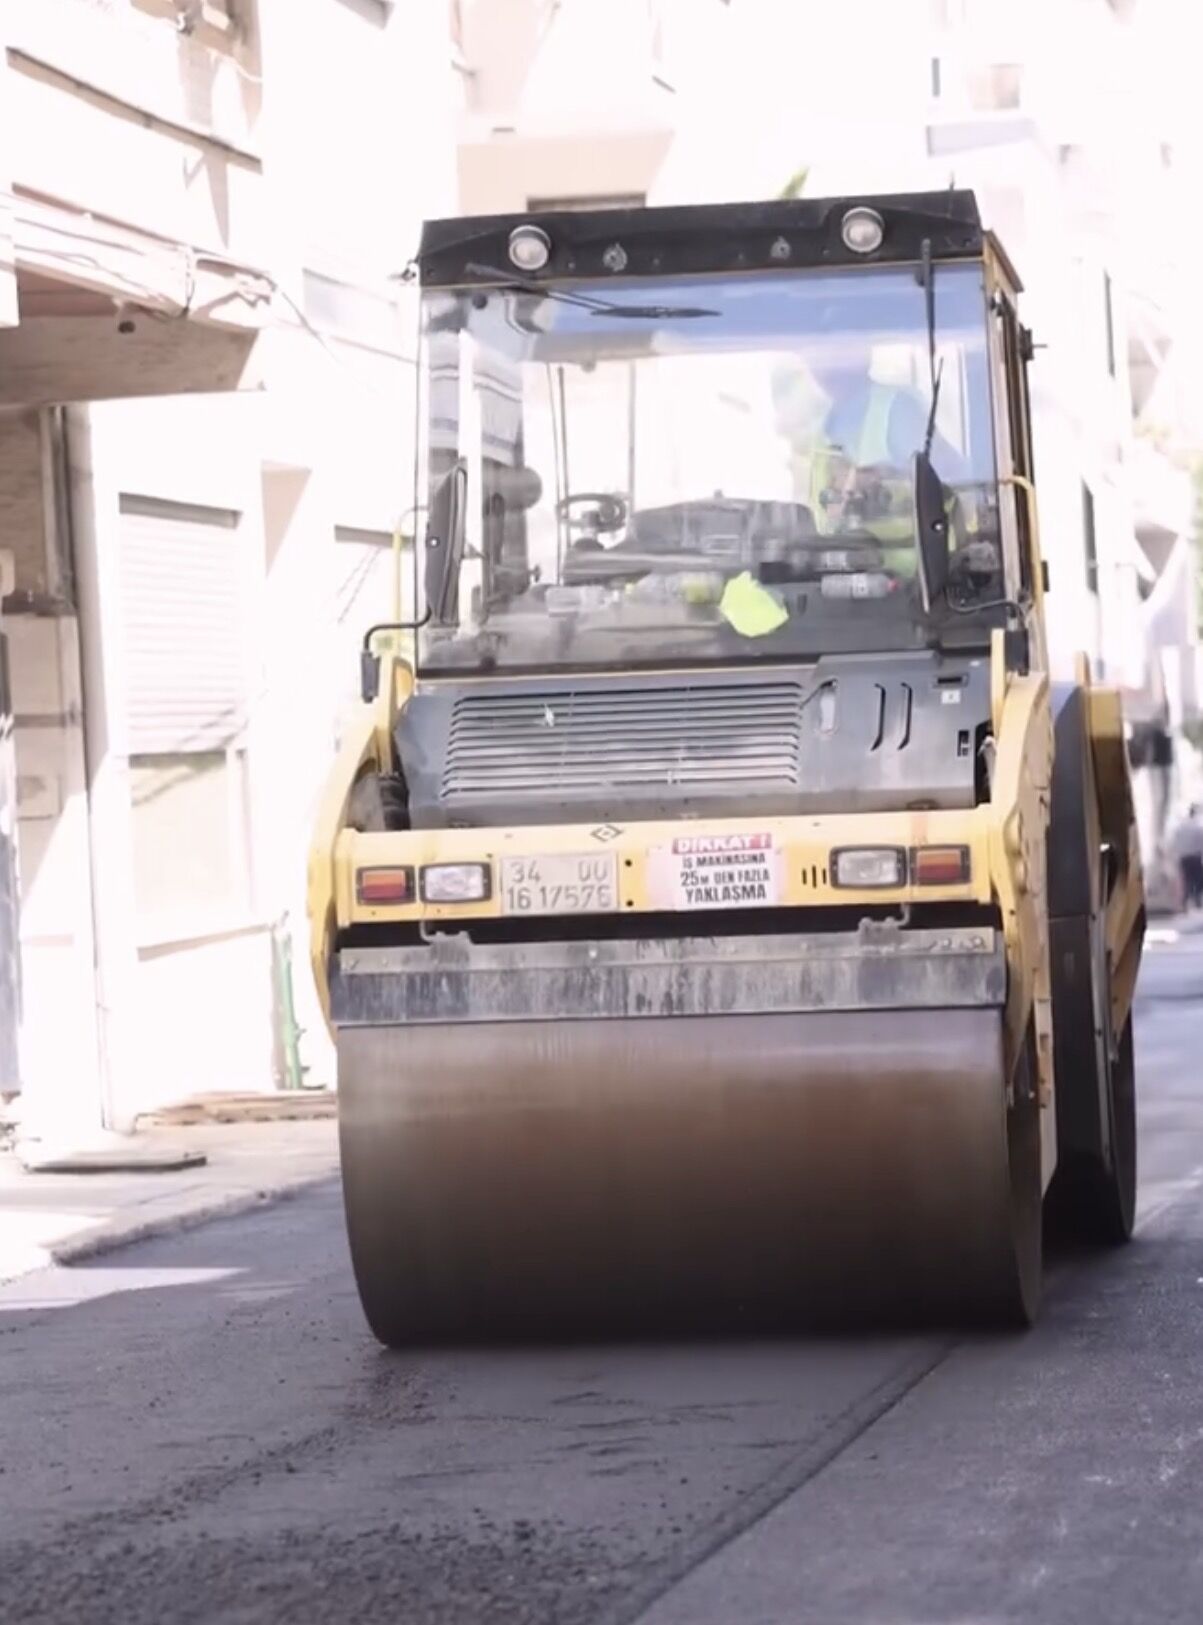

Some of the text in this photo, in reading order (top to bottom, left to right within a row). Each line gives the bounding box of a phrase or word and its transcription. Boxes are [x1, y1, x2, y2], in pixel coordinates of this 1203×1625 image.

[510, 861, 541, 883] 34
[737, 868, 770, 882] FAZLA
[507, 887, 532, 910] 16
